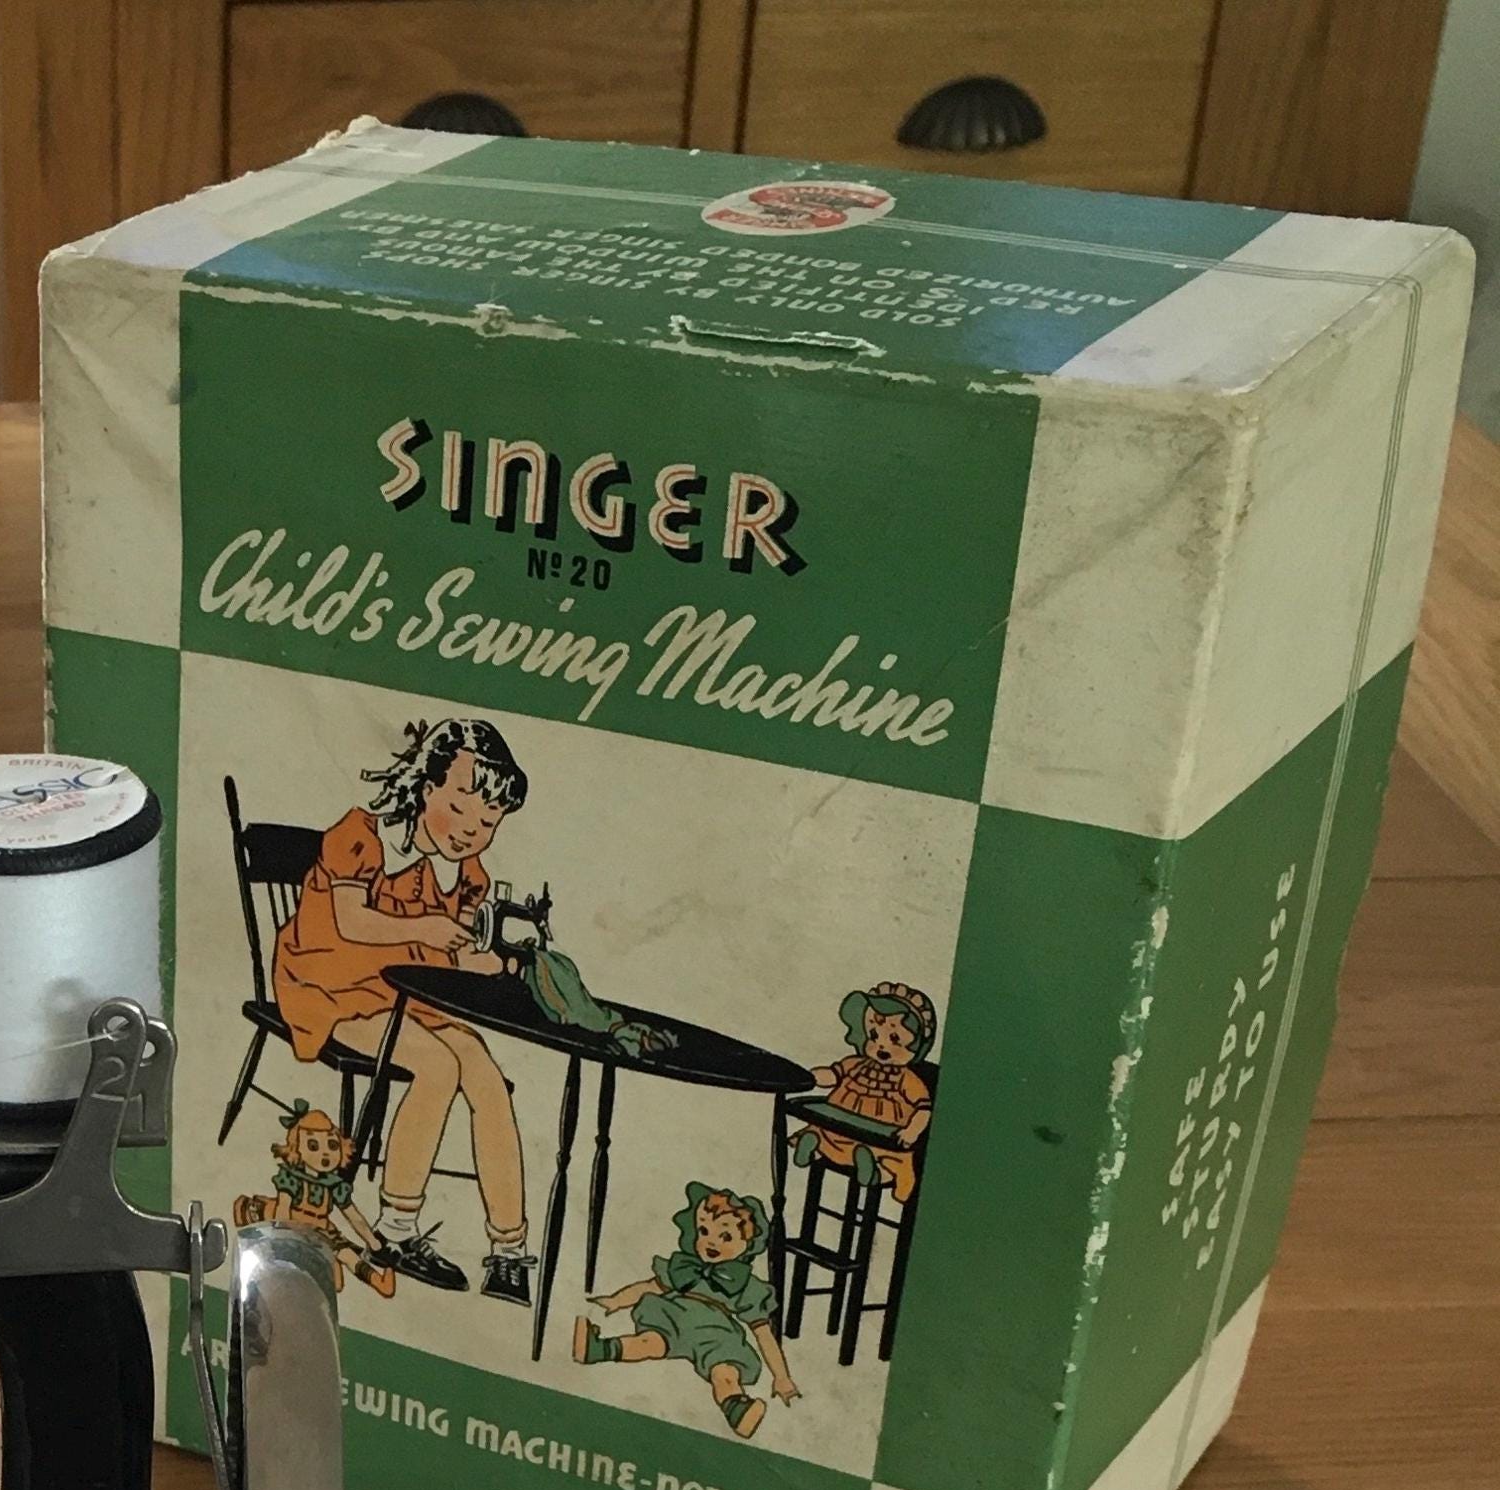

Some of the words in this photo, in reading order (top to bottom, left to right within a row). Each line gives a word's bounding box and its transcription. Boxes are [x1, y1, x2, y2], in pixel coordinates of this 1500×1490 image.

[339, 210, 533, 234] SALESMEN
[415, 230, 504, 244] AND
[546, 229, 684, 249] SINGER
[361, 250, 489, 270] SHOPS
[369, 238, 533, 262] FAMOUS
[514, 240, 709, 267] WINDOW
[700, 246, 862, 272] BONDED
[546, 256, 622, 273] THE
[637, 269, 700, 281] BY
[727, 263, 809, 281] THE
[512, 266, 651, 289] SINGER
[829, 275, 895, 289] ON
[876, 268, 1135, 307] AUTHORIZED
[664, 286, 719, 299] BY
[718, 278, 985, 315] IDENTIFIED
[734, 294, 845, 313] ONLY
[859, 308, 962, 327] SOLD
[989, 297, 1084, 315] RED
[377, 416, 808, 577] SINGER
[571, 555, 611, 591] 20
[200, 528, 394, 642] Child's
[397, 567, 630, 721] Sewing
[636, 606, 956, 746] Machine
[9, 758, 86, 771] BRITAIN
[1197, 1122, 1240, 1270] EASY
[1235, 1010, 1266, 1101] TO
[1258, 863, 1296, 990] USE
[1182, 977, 1246, 1239] STURDY
[1162, 1067, 1206, 1226] SAFE
[341, 1377, 450, 1437] EWING
